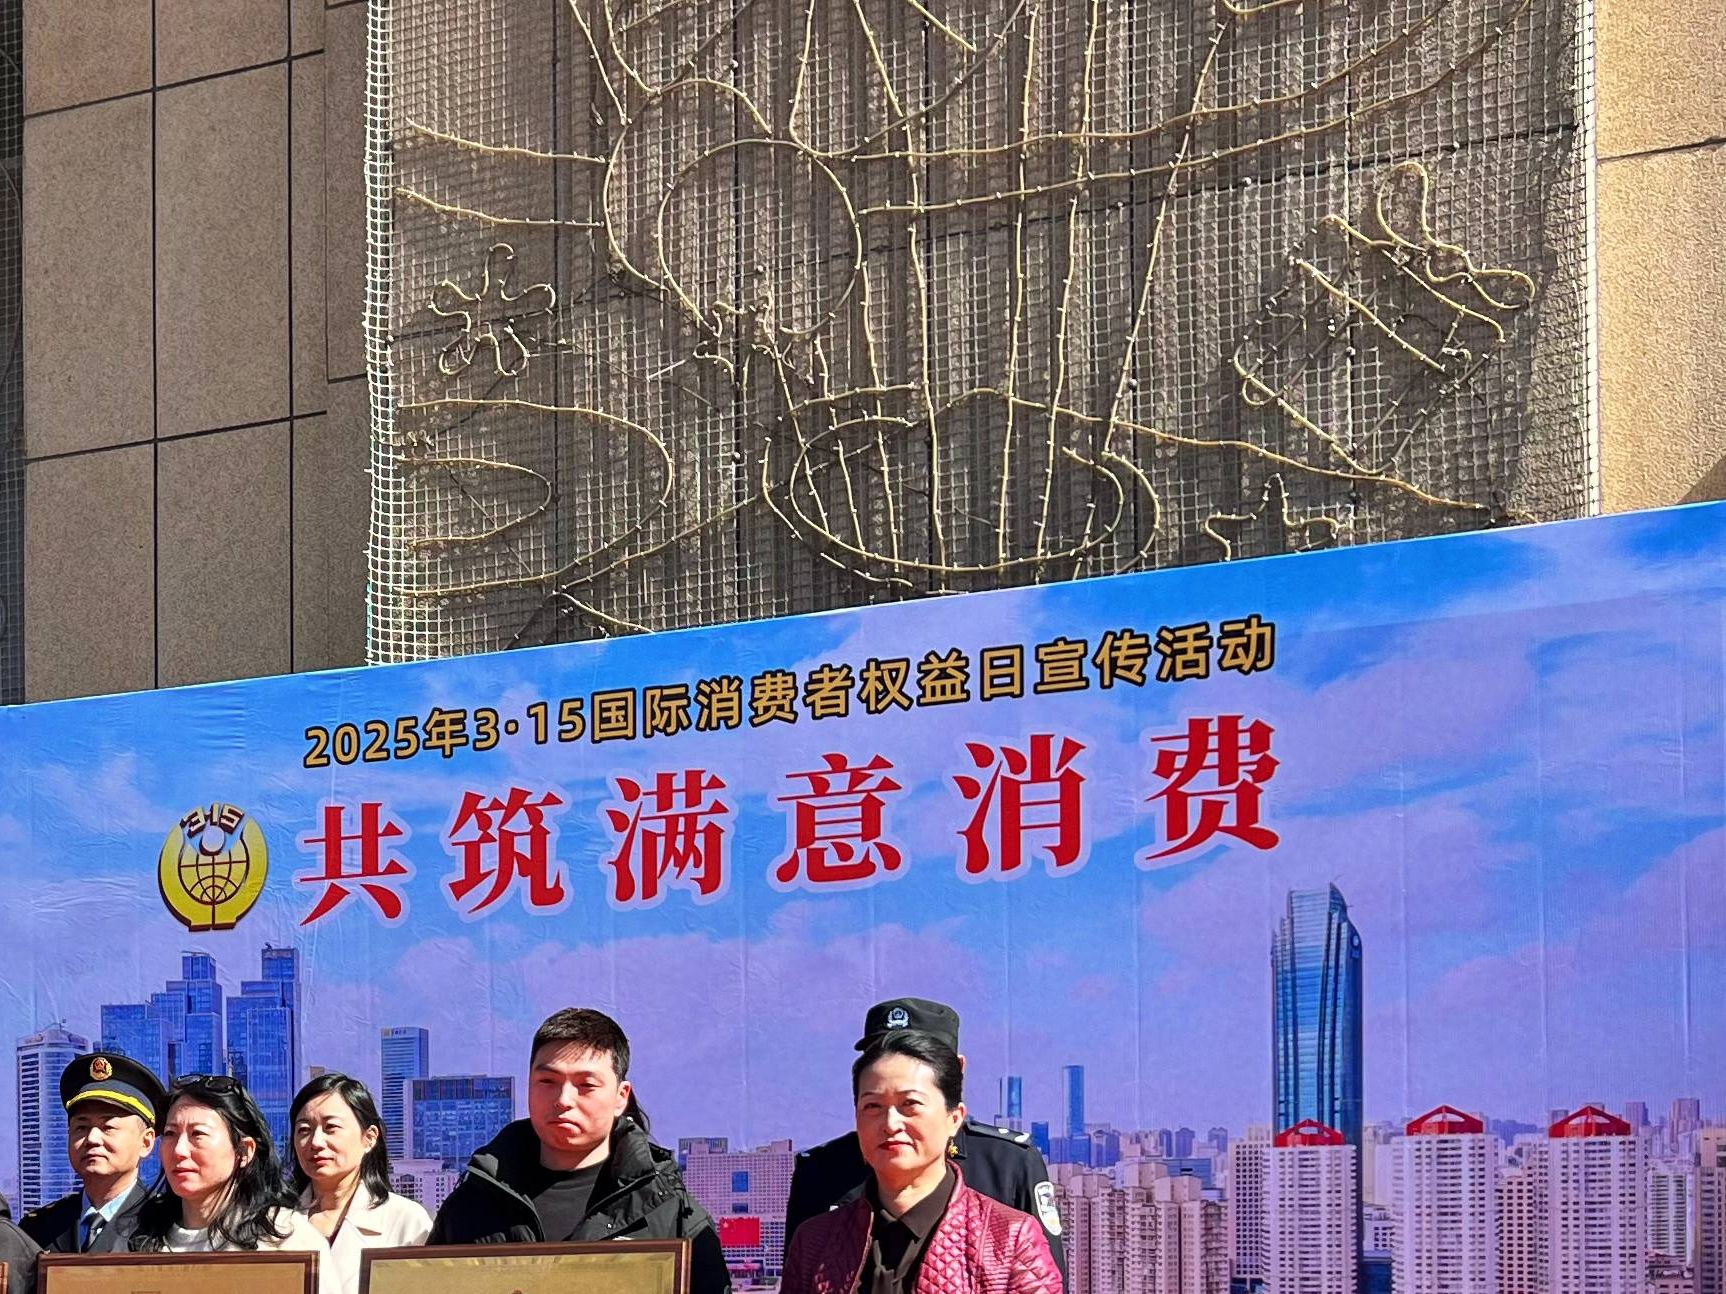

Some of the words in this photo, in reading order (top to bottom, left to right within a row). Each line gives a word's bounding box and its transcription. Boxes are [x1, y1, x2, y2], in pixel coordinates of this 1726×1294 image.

[303, 617, 1277, 769] 2025年3·15国际消费者权益日宣传活动
[299, 713, 1283, 928] 共筑满意消费
